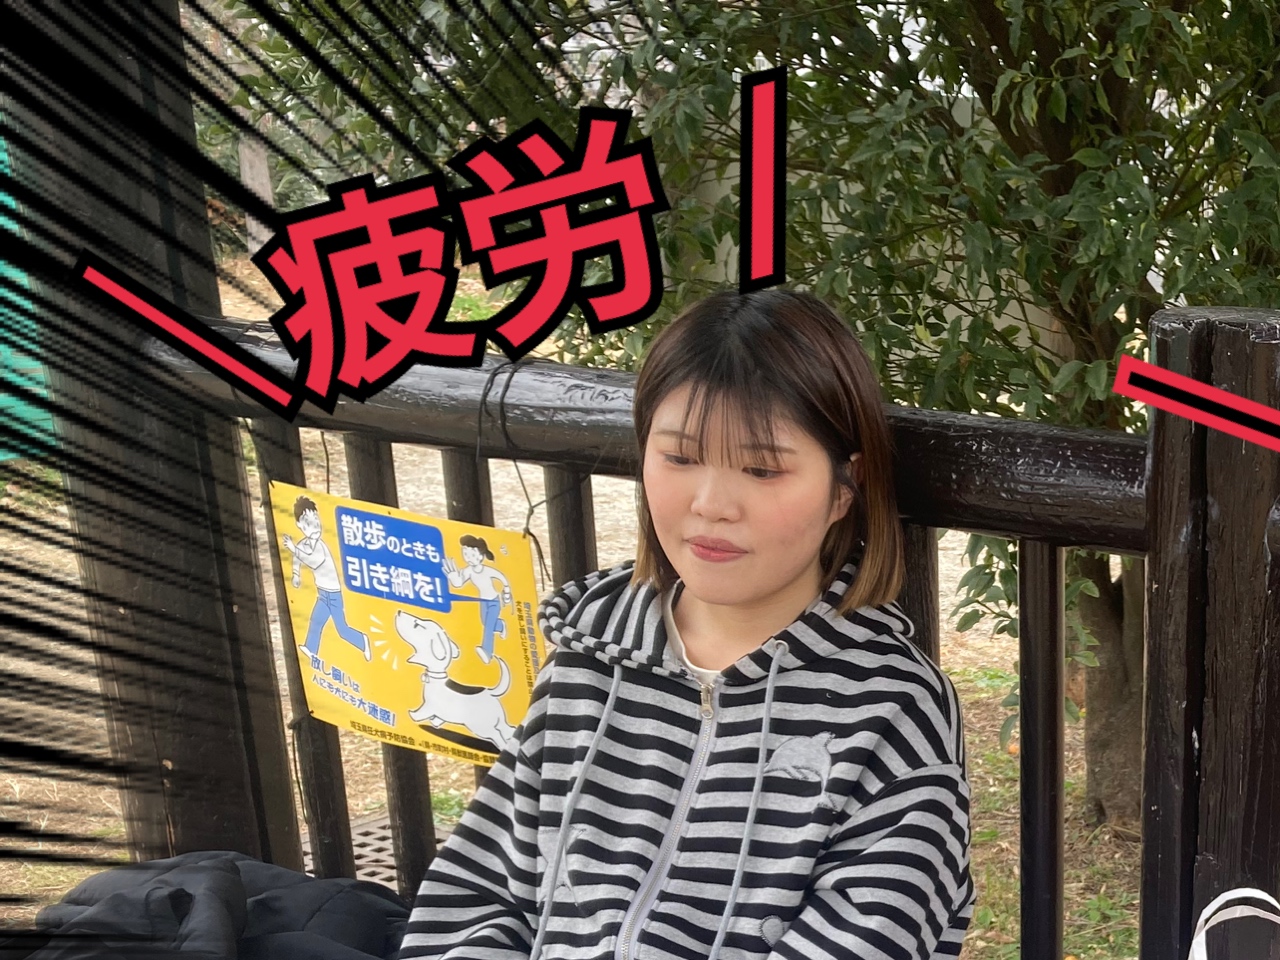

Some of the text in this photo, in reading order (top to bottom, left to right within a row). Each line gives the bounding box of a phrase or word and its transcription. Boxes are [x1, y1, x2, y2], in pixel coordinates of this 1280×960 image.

[341, 513, 440, 563] 散歩のときも
